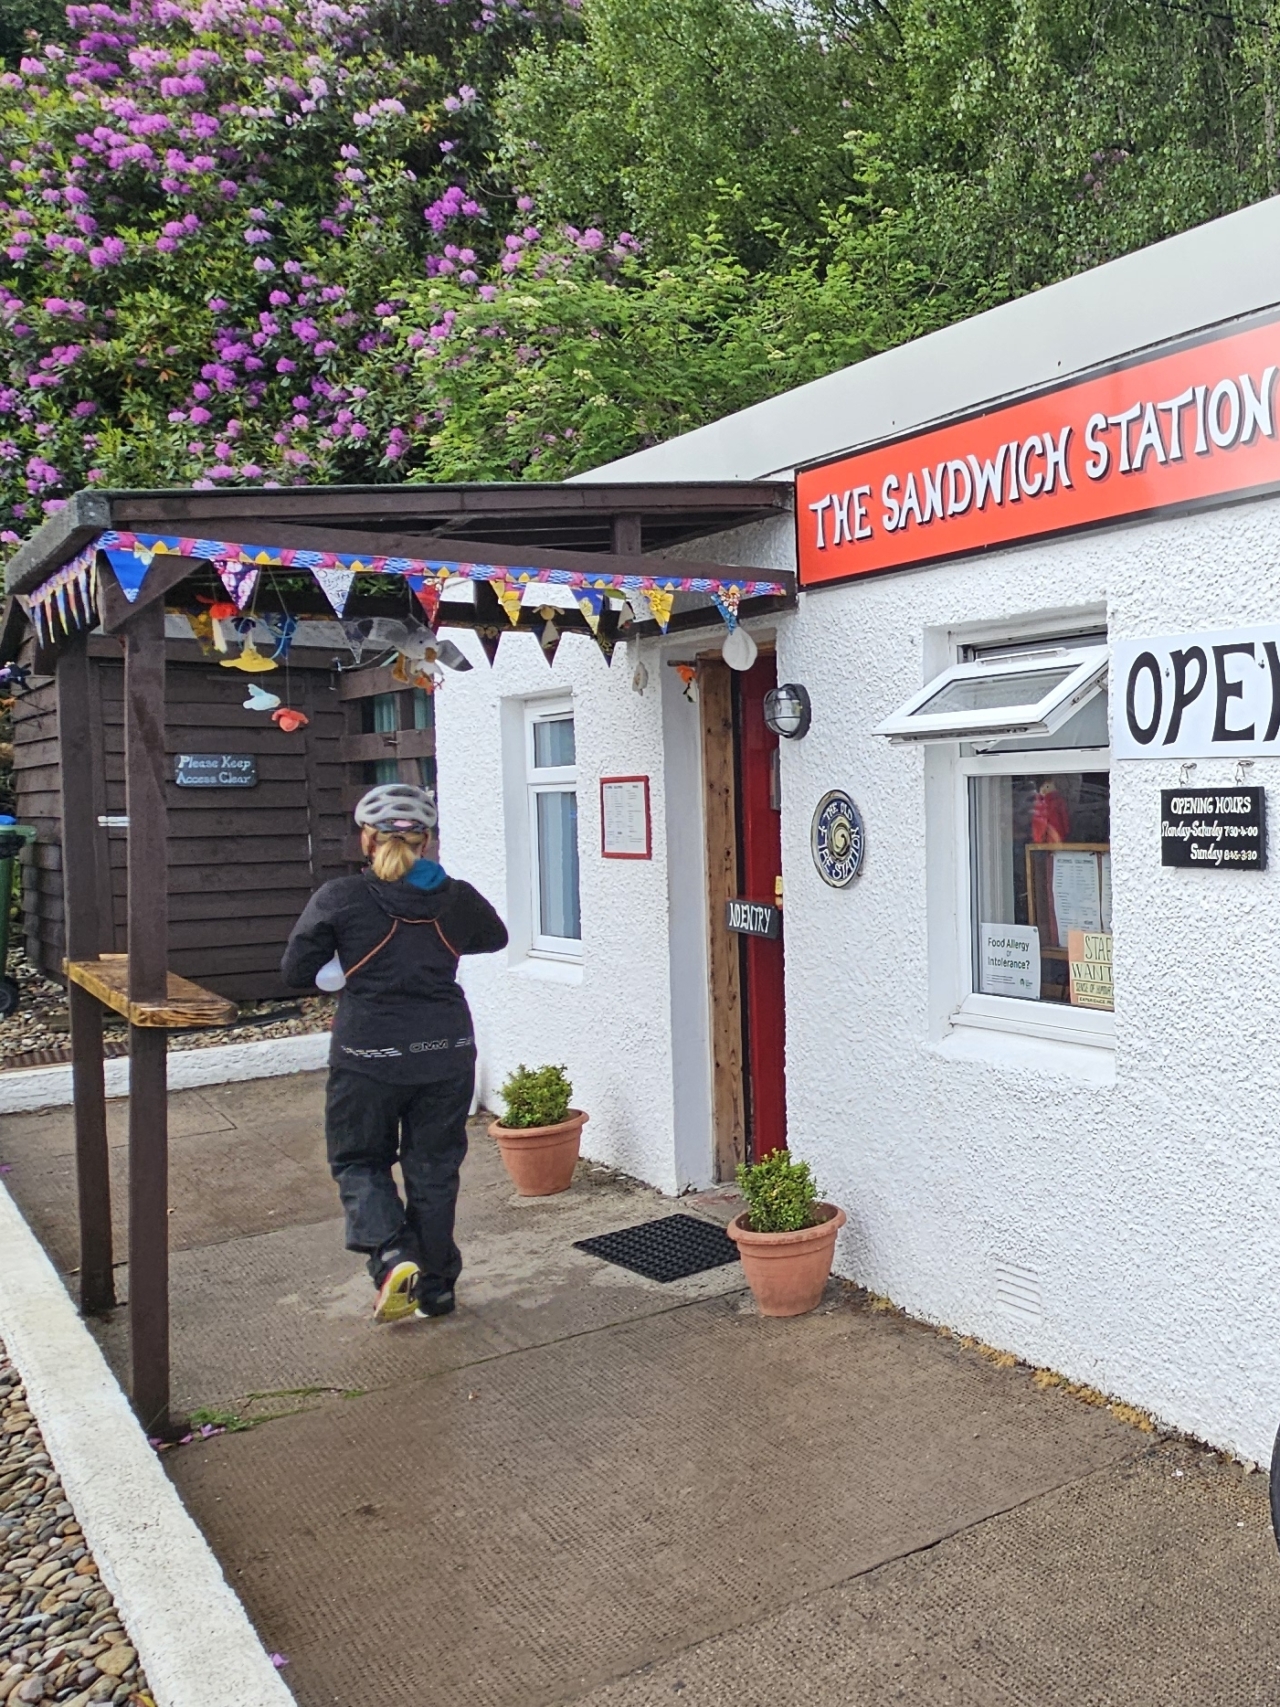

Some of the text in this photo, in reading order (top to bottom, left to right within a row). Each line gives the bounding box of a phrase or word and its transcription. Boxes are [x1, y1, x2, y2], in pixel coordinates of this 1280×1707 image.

[808, 365, 1280, 550] THE SANDWICH STATION
[178, 755, 251, 771] Please Keep
[176, 771, 251, 784] Access Clear
[823, 802, 853, 821] THE OLD
[1171, 796, 1251, 814] OPENING HOURS
[818, 825, 861, 880] FIRE STATION
[1190, 843, 1223, 866] Sunday
[729, 902, 771, 933] NO ENTRY
[987, 937, 1029, 952] Food Allergy
[987, 956, 1031, 970] Intolerance?
[409, 1039, 448, 1053] OMM
